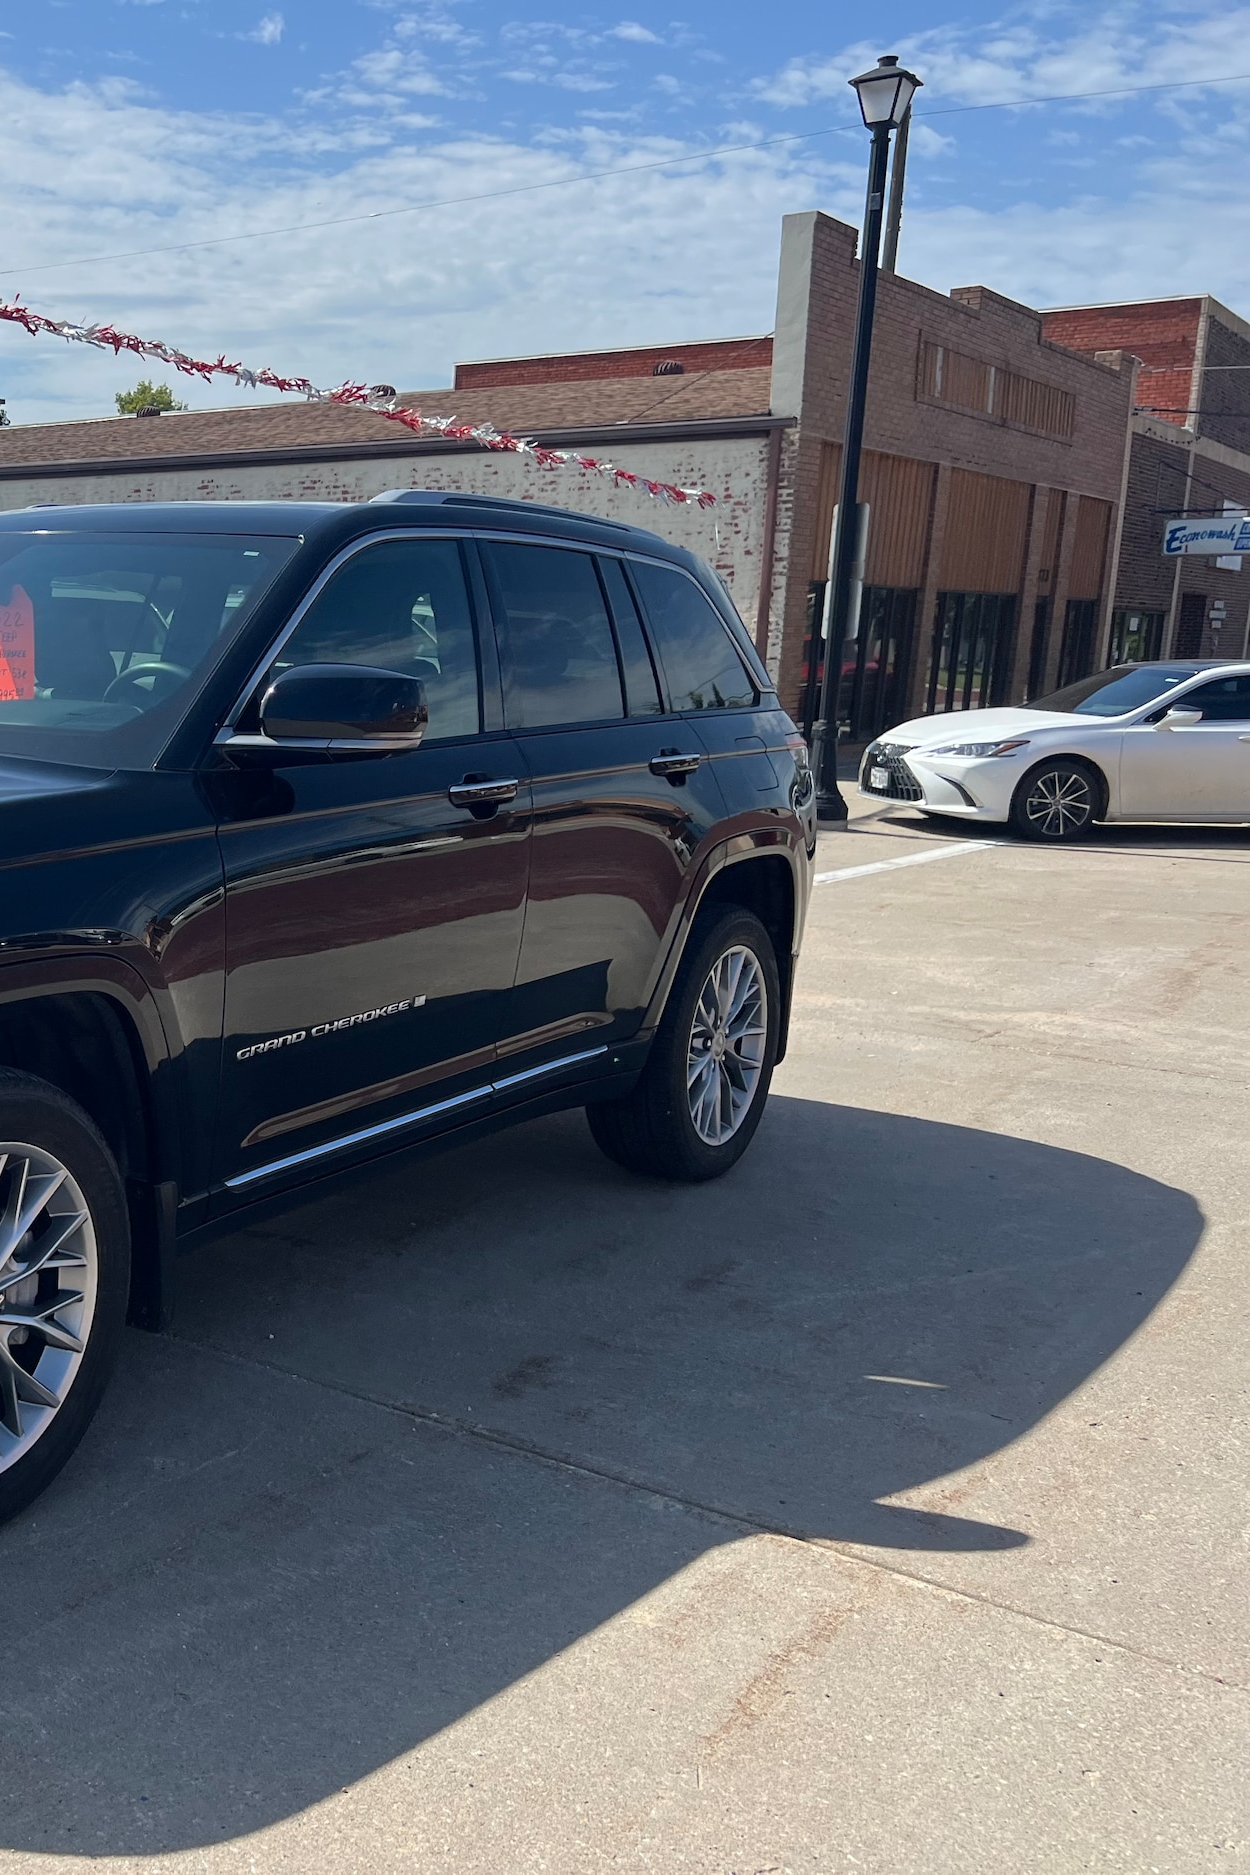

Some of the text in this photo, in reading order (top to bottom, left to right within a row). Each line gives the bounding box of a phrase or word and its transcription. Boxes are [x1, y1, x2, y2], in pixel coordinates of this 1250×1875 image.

[1165, 523, 1237, 553] Econowash
[236, 999, 410, 1061] GRAND CHEROKEE
